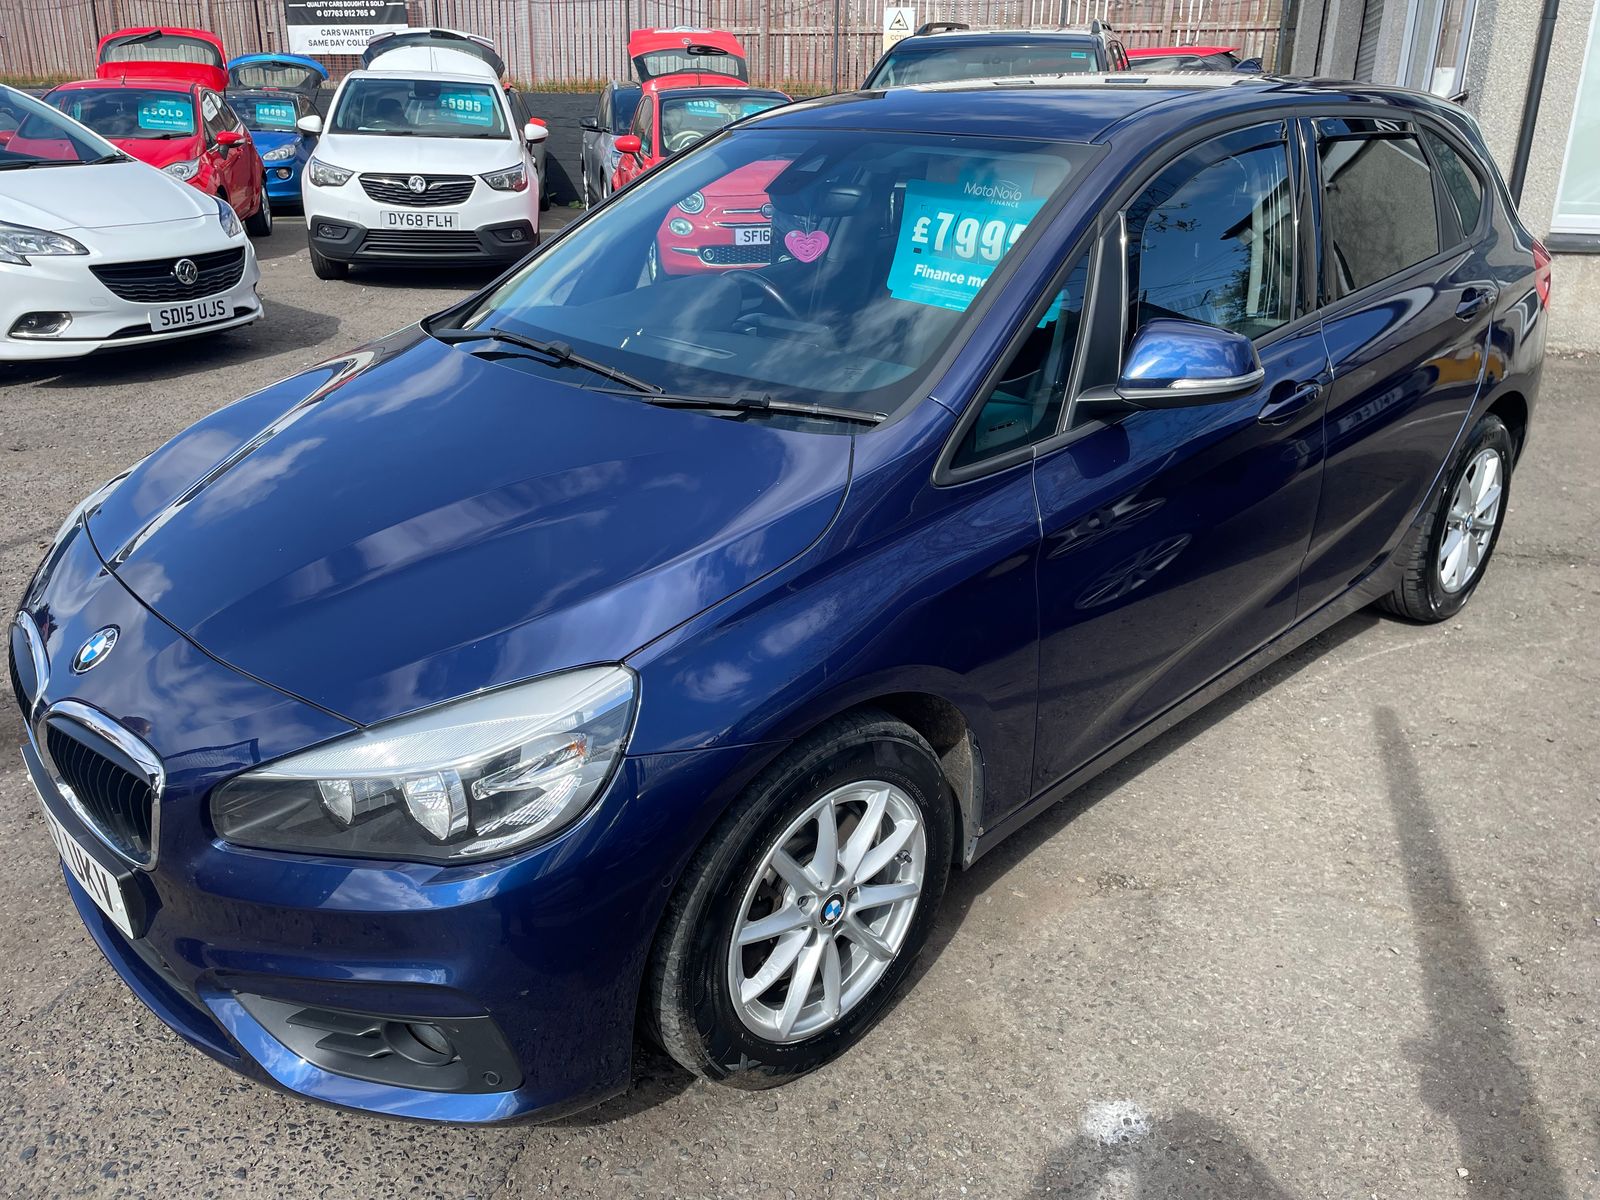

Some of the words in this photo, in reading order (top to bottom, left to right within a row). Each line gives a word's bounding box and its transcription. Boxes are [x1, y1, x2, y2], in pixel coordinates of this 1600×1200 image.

[323, 9, 343, 17] 07763
[344, 9, 356, 17] 912
[356, 9, 369, 17] 765
[342, 28, 375, 36] WANTED
[308, 39, 329, 47] SAME
[330, 39, 345, 47] DAY
[441, 97, 482, 112] £5995
[963, 181, 1022, 201] MotoNovo
[990, 199, 1020, 209] FINANCE
[388, 212, 423, 226] DY68
[426, 214, 453, 228] FLH
[743, 230, 770, 242] SF16
[913, 263, 965, 284] Finance
[160, 305, 195, 326] SD15
[197, 300, 226, 319] UJS
